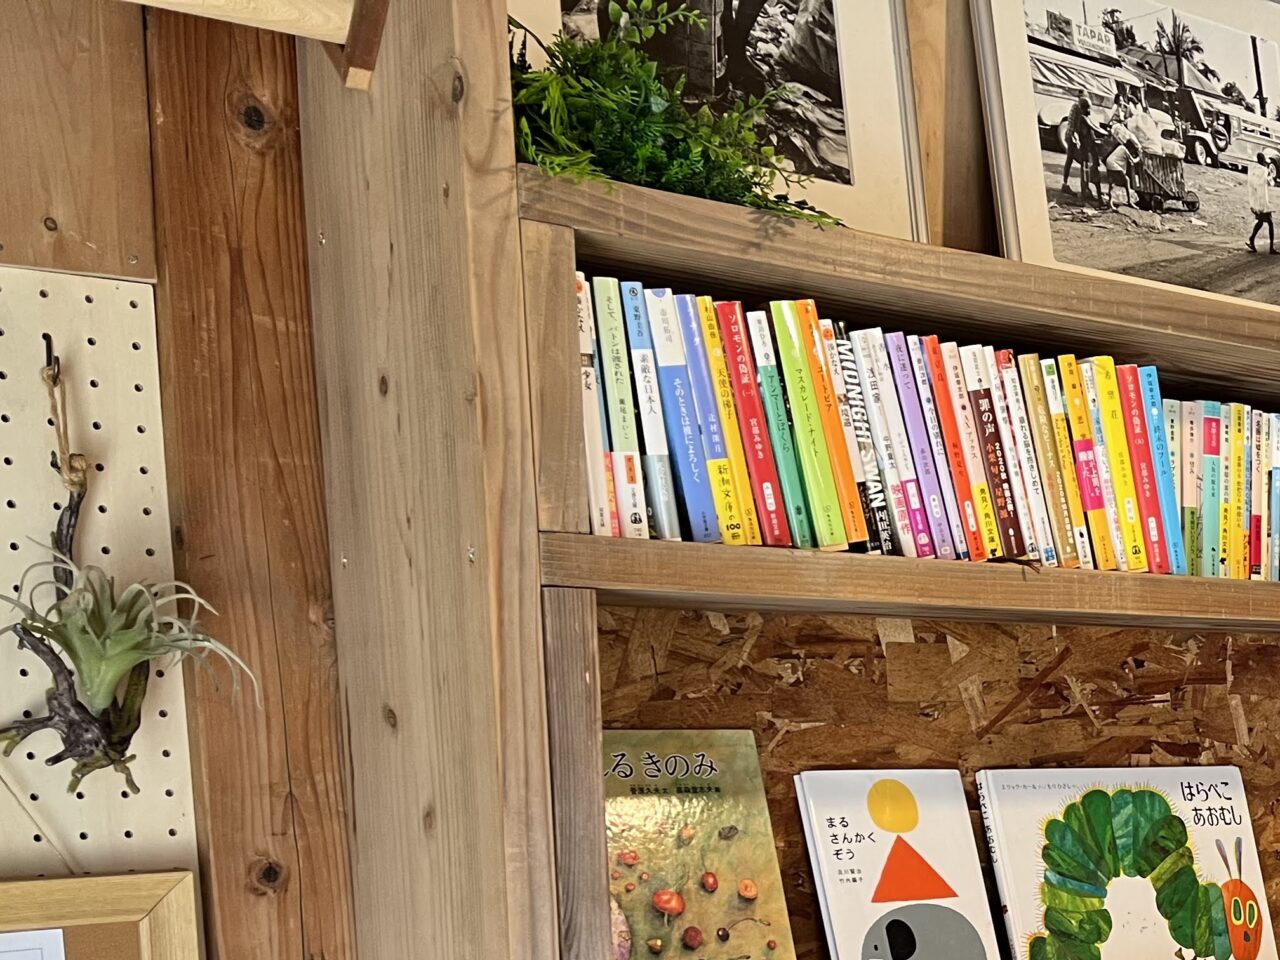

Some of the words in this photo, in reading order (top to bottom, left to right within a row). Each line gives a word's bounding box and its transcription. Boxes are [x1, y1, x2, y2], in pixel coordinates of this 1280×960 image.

[606, 296, 625, 385] そして、バトンは渡された
[728, 314, 750, 385] ソロモンの偽証
[640, 354, 657, 415] 素敵な日本人
[795, 368, 819, 458] マスカレード・ナイト
[1126, 375, 1143, 434] ソロモンの偽証
[673, 377, 700, 483] そのときは彼によろしく
[836, 339, 872, 442] MIDNIGHT
[859, 444, 887, 508] SWAN
[978, 398, 995, 437] 罪の声
[1019, 416, 1040, 495] 崩れる脳を抱きしめて
[604, 752, 718, 779] るきのみ
[1180, 781, 1233, 802] はらぺこ
[826, 816, 849, 828] まる
[829, 832, 877, 845] さんかく
[1191, 806, 1242, 827] あおむし
[832, 848, 855, 861] ぞう
